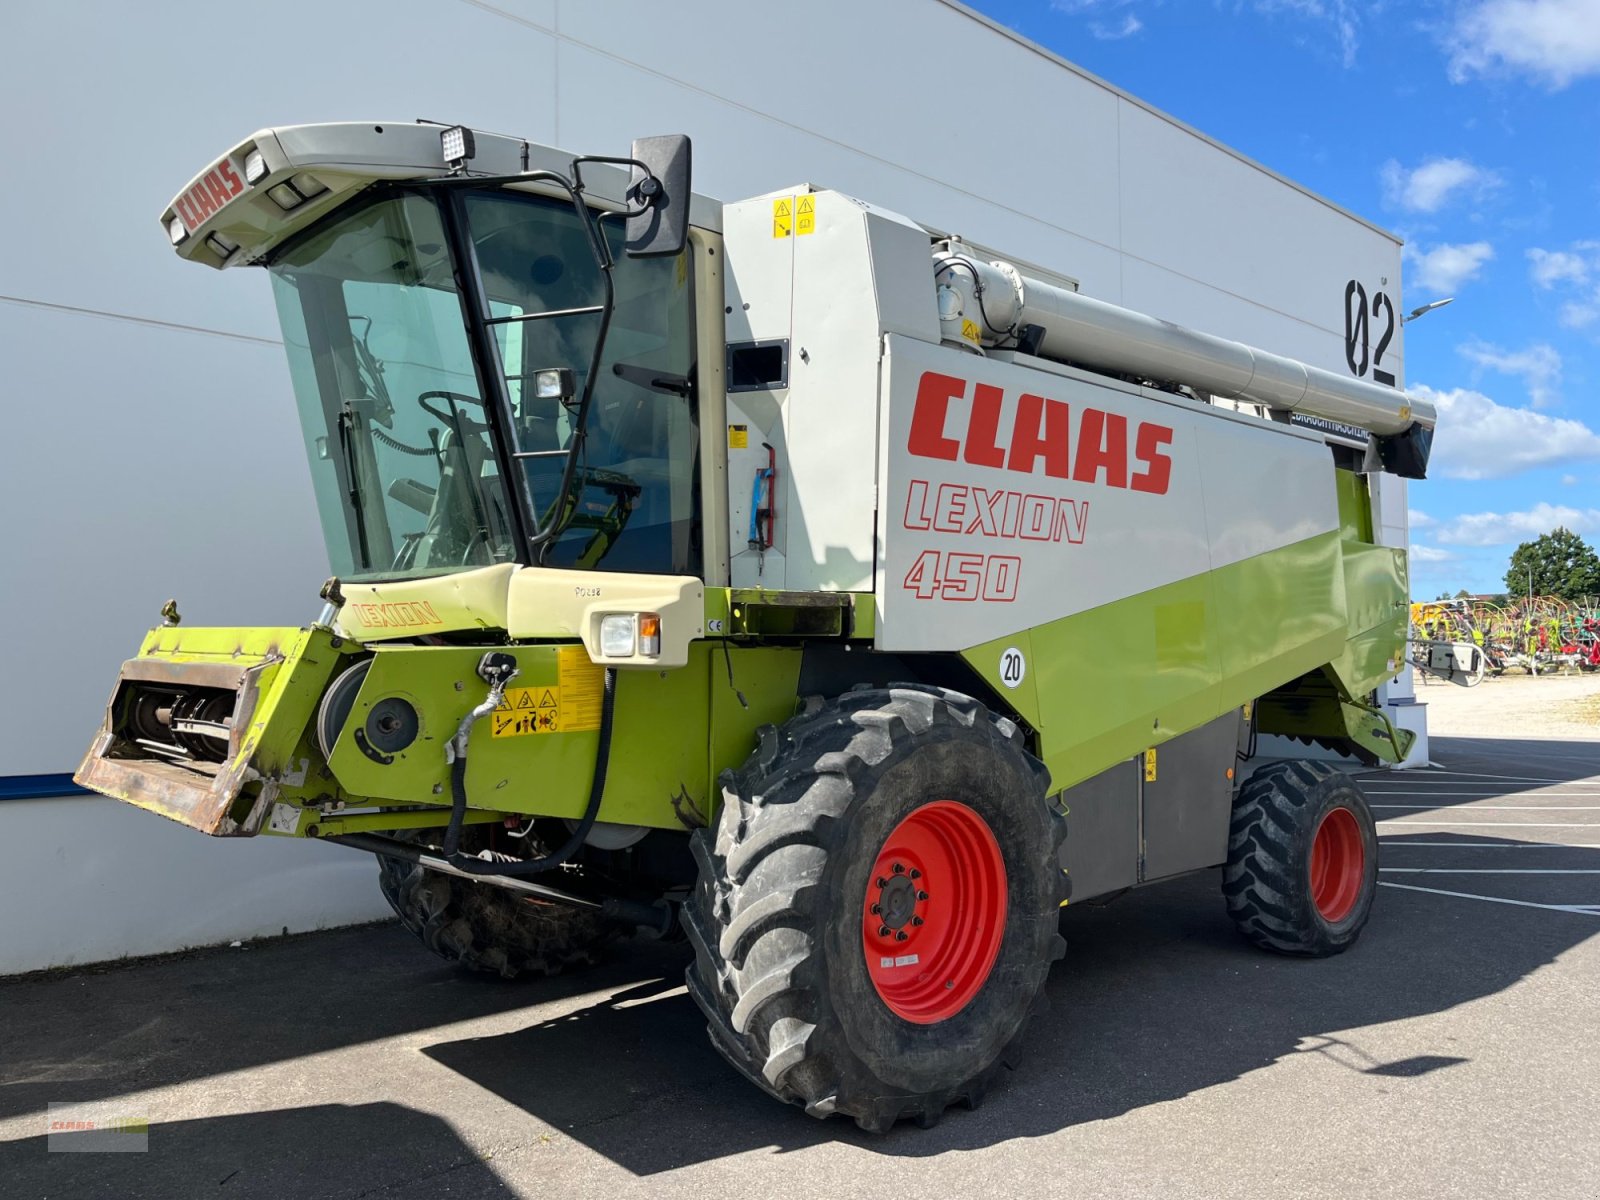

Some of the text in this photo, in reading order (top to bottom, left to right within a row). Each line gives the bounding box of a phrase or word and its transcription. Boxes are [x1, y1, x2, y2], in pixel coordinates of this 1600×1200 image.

[175, 158, 245, 231] CLAAS
[1345, 279, 1395, 387] 02
[907, 371, 1173, 495] CLAAS
[903, 479, 1089, 544] LEXION
[903, 550, 1021, 602] 450
[352, 601, 443, 627] LEXION
[1004, 653, 1021, 682] 20
